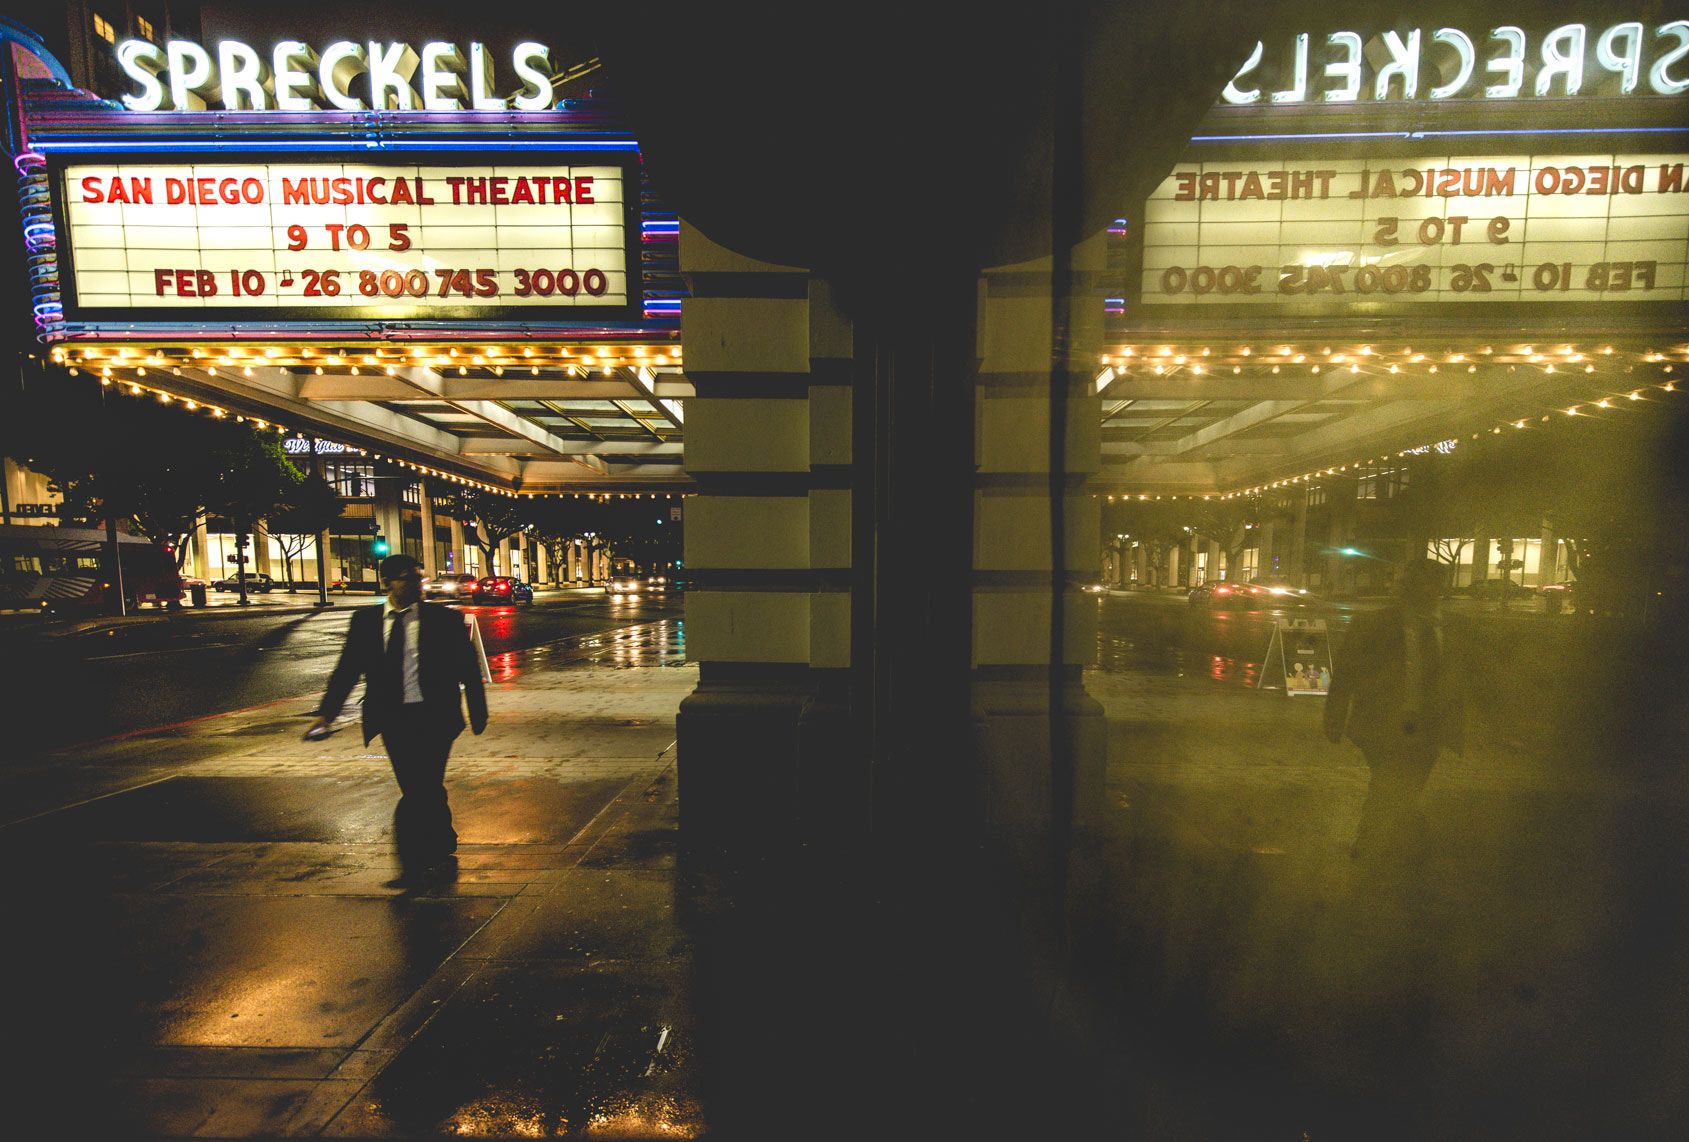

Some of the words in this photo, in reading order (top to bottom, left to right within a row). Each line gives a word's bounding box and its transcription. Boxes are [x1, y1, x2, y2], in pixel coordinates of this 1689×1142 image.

[118, 39, 553, 110] SPRECKELS
[82, 176, 153, 204] SAN
[165, 177, 264, 205] DIEGO
[282, 176, 434, 205] MUSICAL
[446, 176, 595, 205] THEATRE
[287, 224, 308, 251] 9
[325, 224, 370, 251] TO
[388, 224, 411, 251] 5
[154, 269, 218, 297] FEB
[231, 269, 266, 297] 10
[358, 269, 429, 298] 800
[435, 268, 500, 298] 745
[514, 268, 607, 298] 3000
